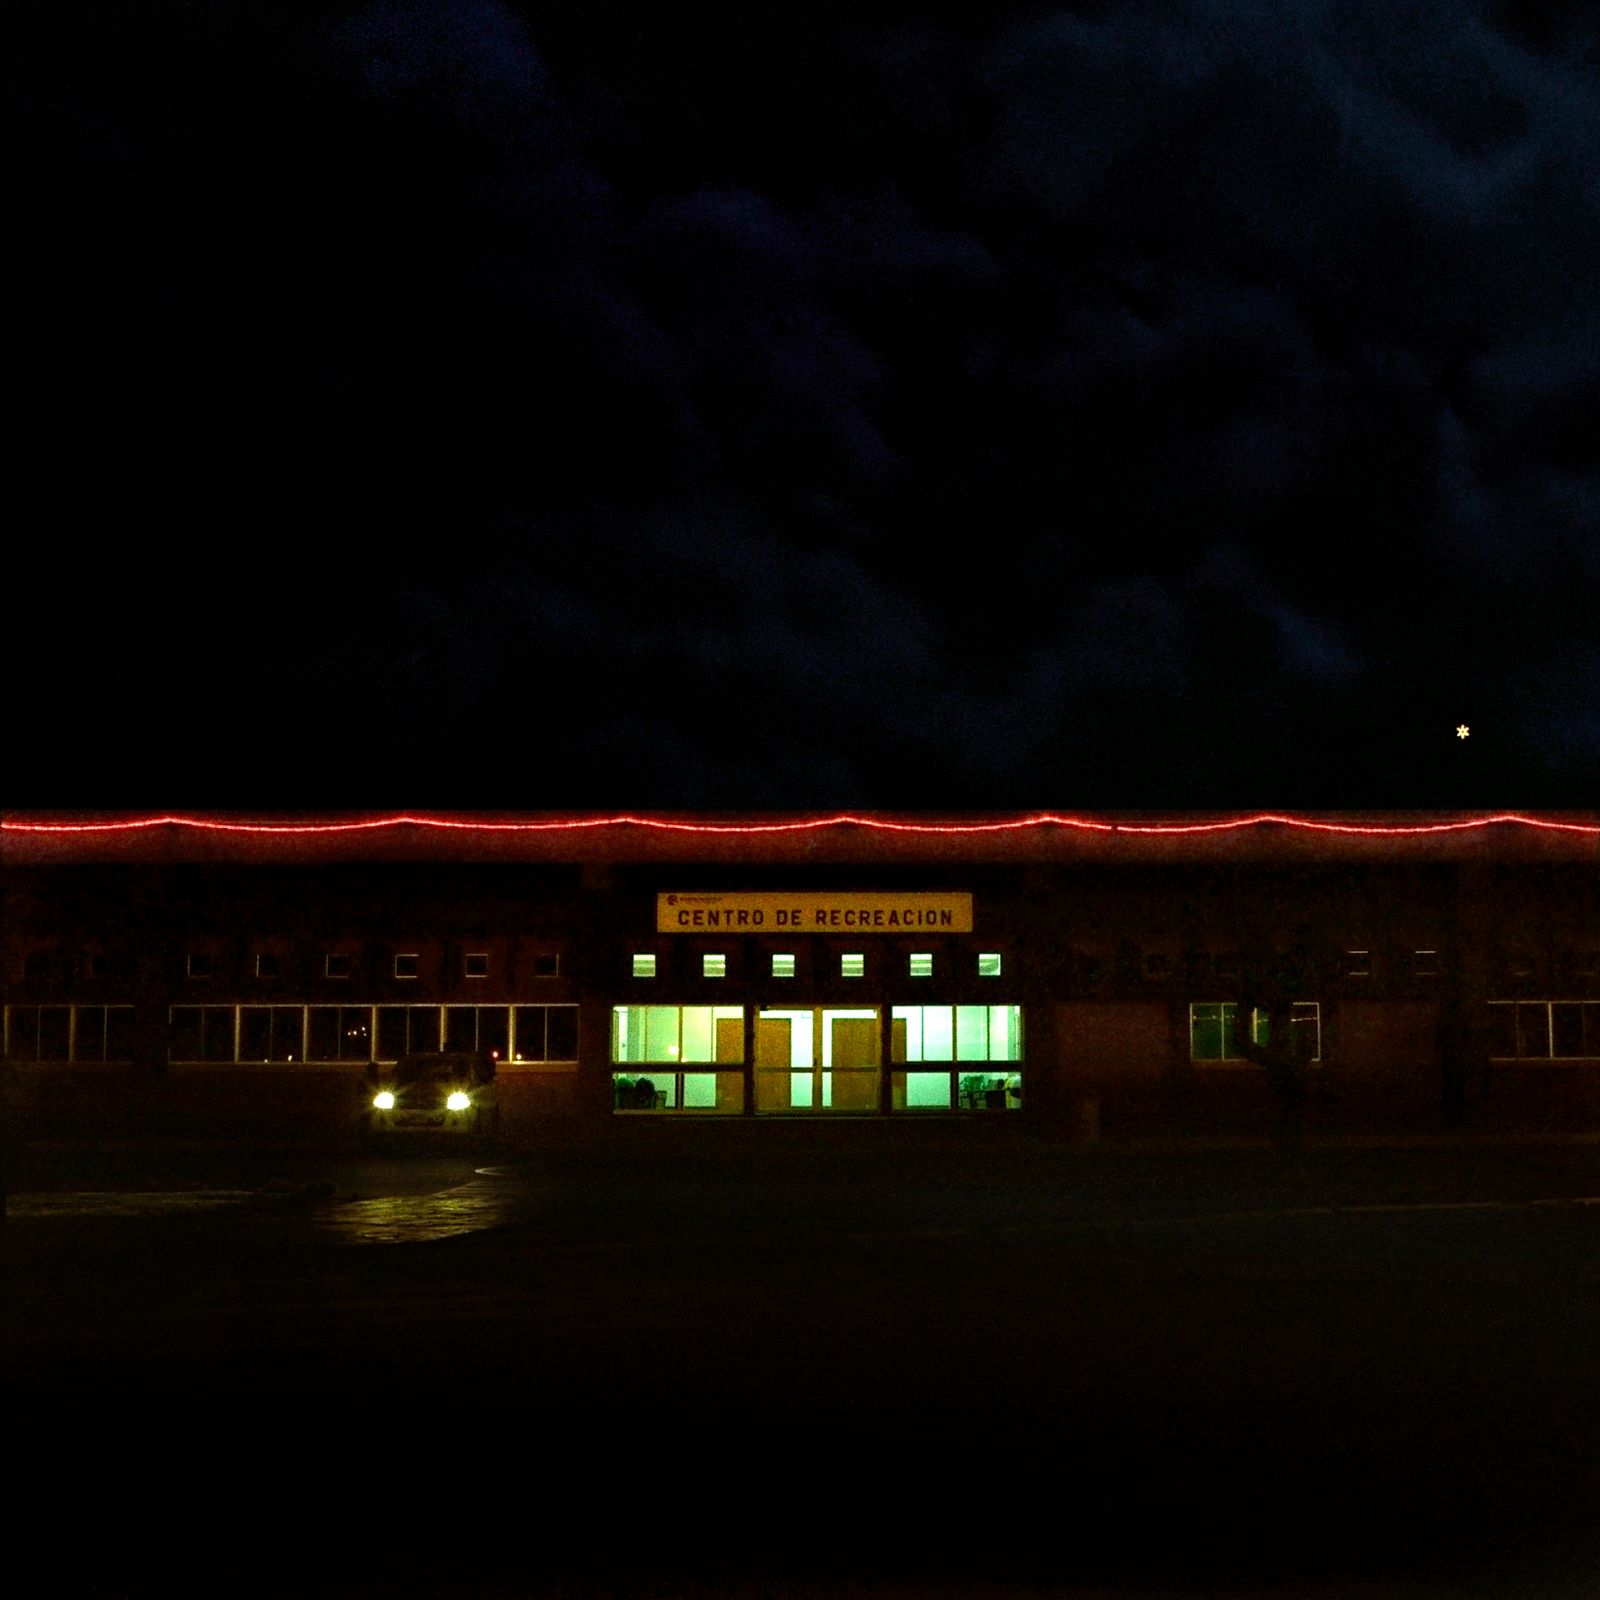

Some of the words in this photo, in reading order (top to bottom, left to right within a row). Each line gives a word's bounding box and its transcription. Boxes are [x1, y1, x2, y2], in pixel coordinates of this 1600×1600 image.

[678, 909, 764, 926] CENTRO
[776, 909, 802, 926] DE
[815, 909, 952, 926] RECREACION
